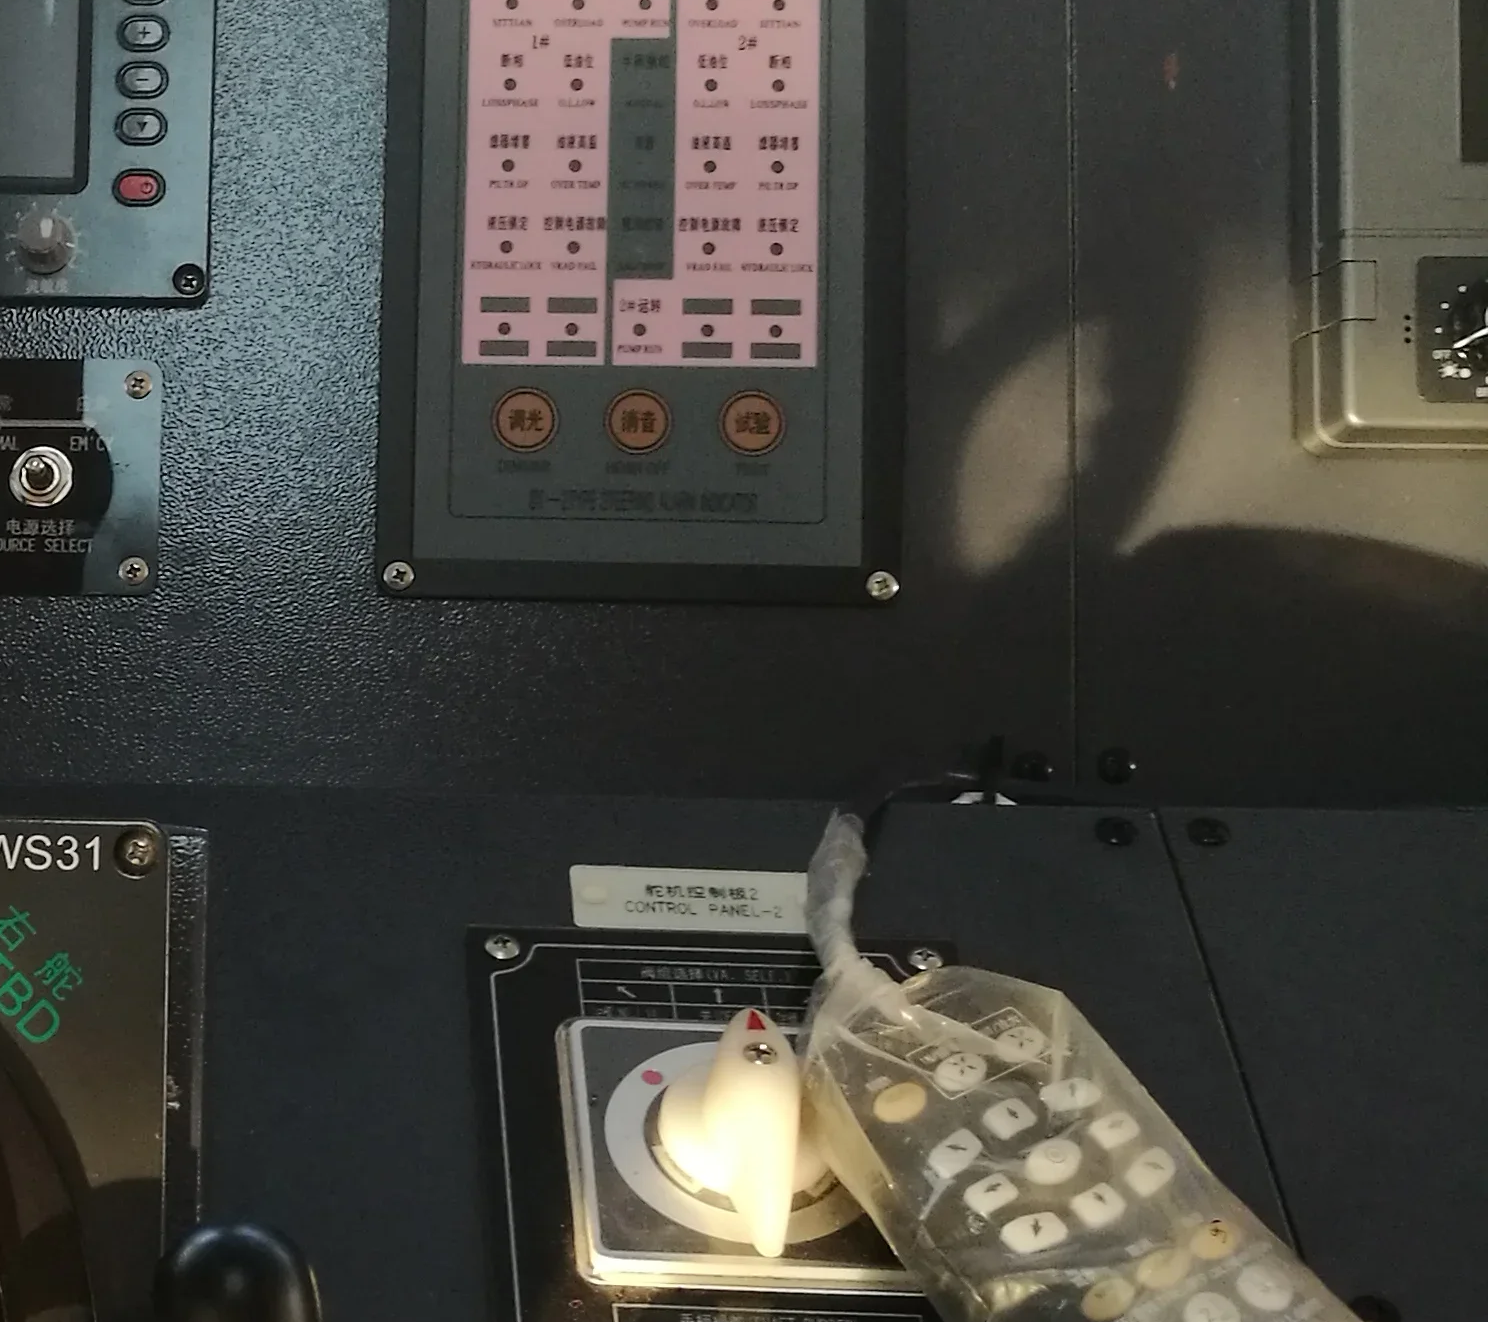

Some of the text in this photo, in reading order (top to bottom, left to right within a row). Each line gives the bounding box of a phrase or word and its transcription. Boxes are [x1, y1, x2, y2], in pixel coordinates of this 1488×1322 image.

[532, 35, 550, 49] 1#
[738, 35, 757, 51] 2#
[6, 519, 76, 537] 电源选择
[44, 538, 94, 554] SELECT
[623, 899, 784, 920] CONTROL PANEL-2
